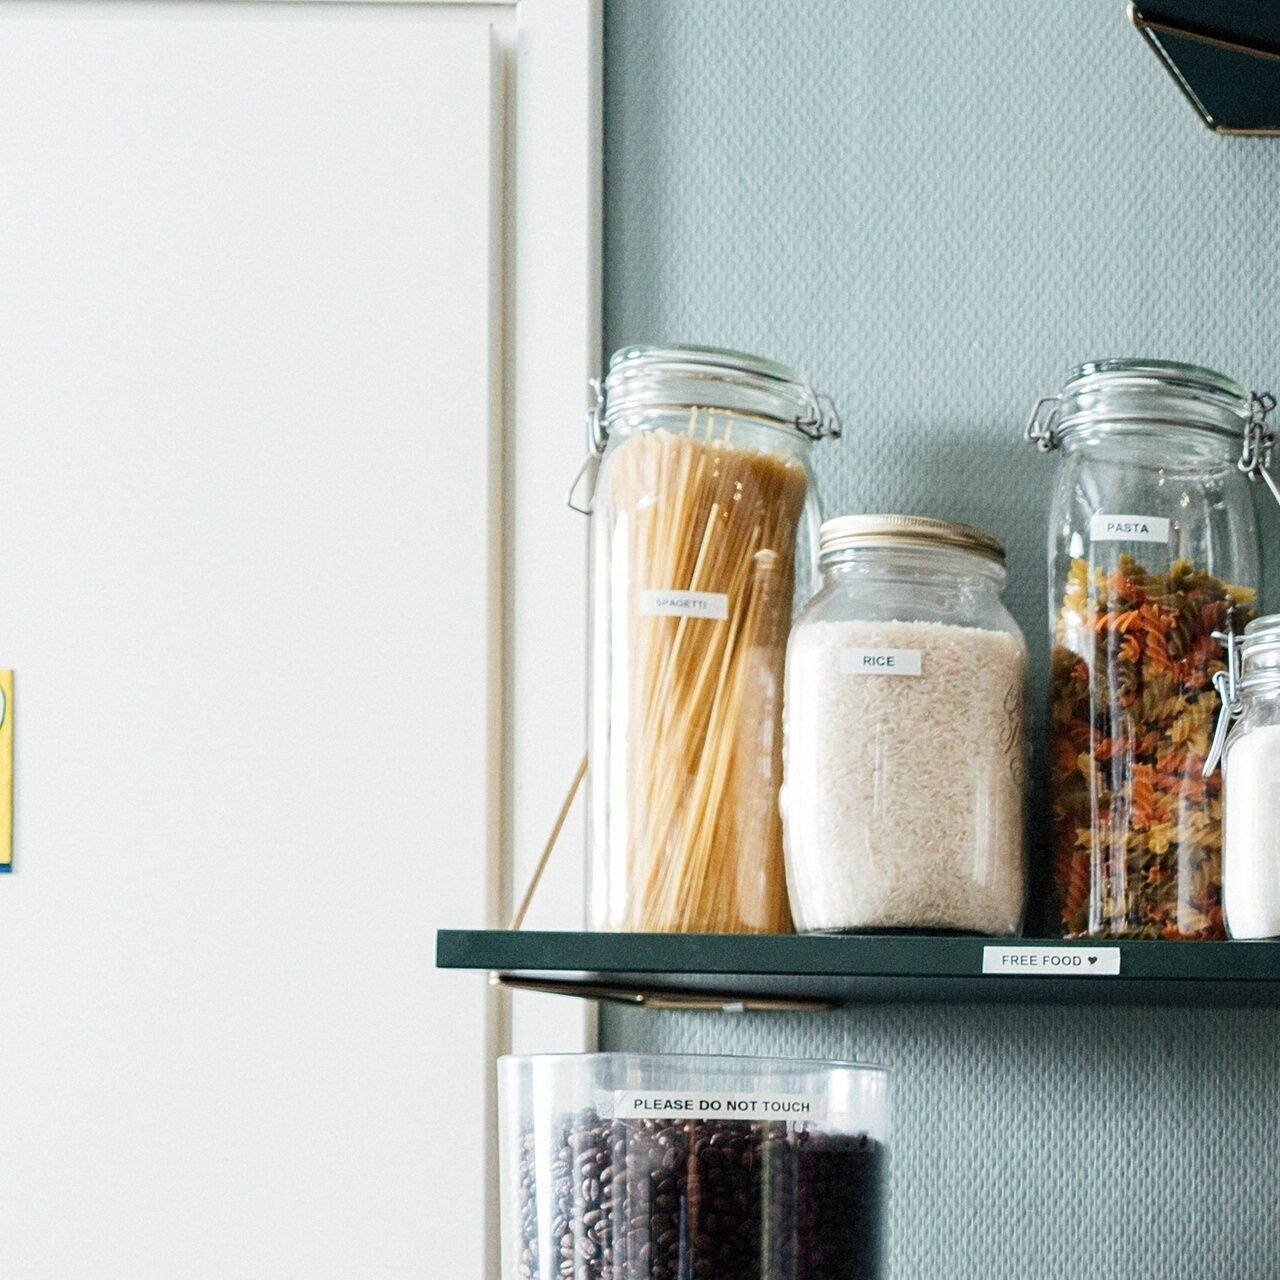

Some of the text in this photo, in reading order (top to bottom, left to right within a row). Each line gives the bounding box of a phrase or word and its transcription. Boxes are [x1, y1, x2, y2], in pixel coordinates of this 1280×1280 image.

[1107, 523, 1149, 534] PASTA
[655, 598, 708, 609] SPAGETTI
[863, 655, 896, 667] RICE
[1001, 955, 1082, 966] FREE FOOD
[633, 1098, 811, 1113] PLEASE DO NOT TOUCH
